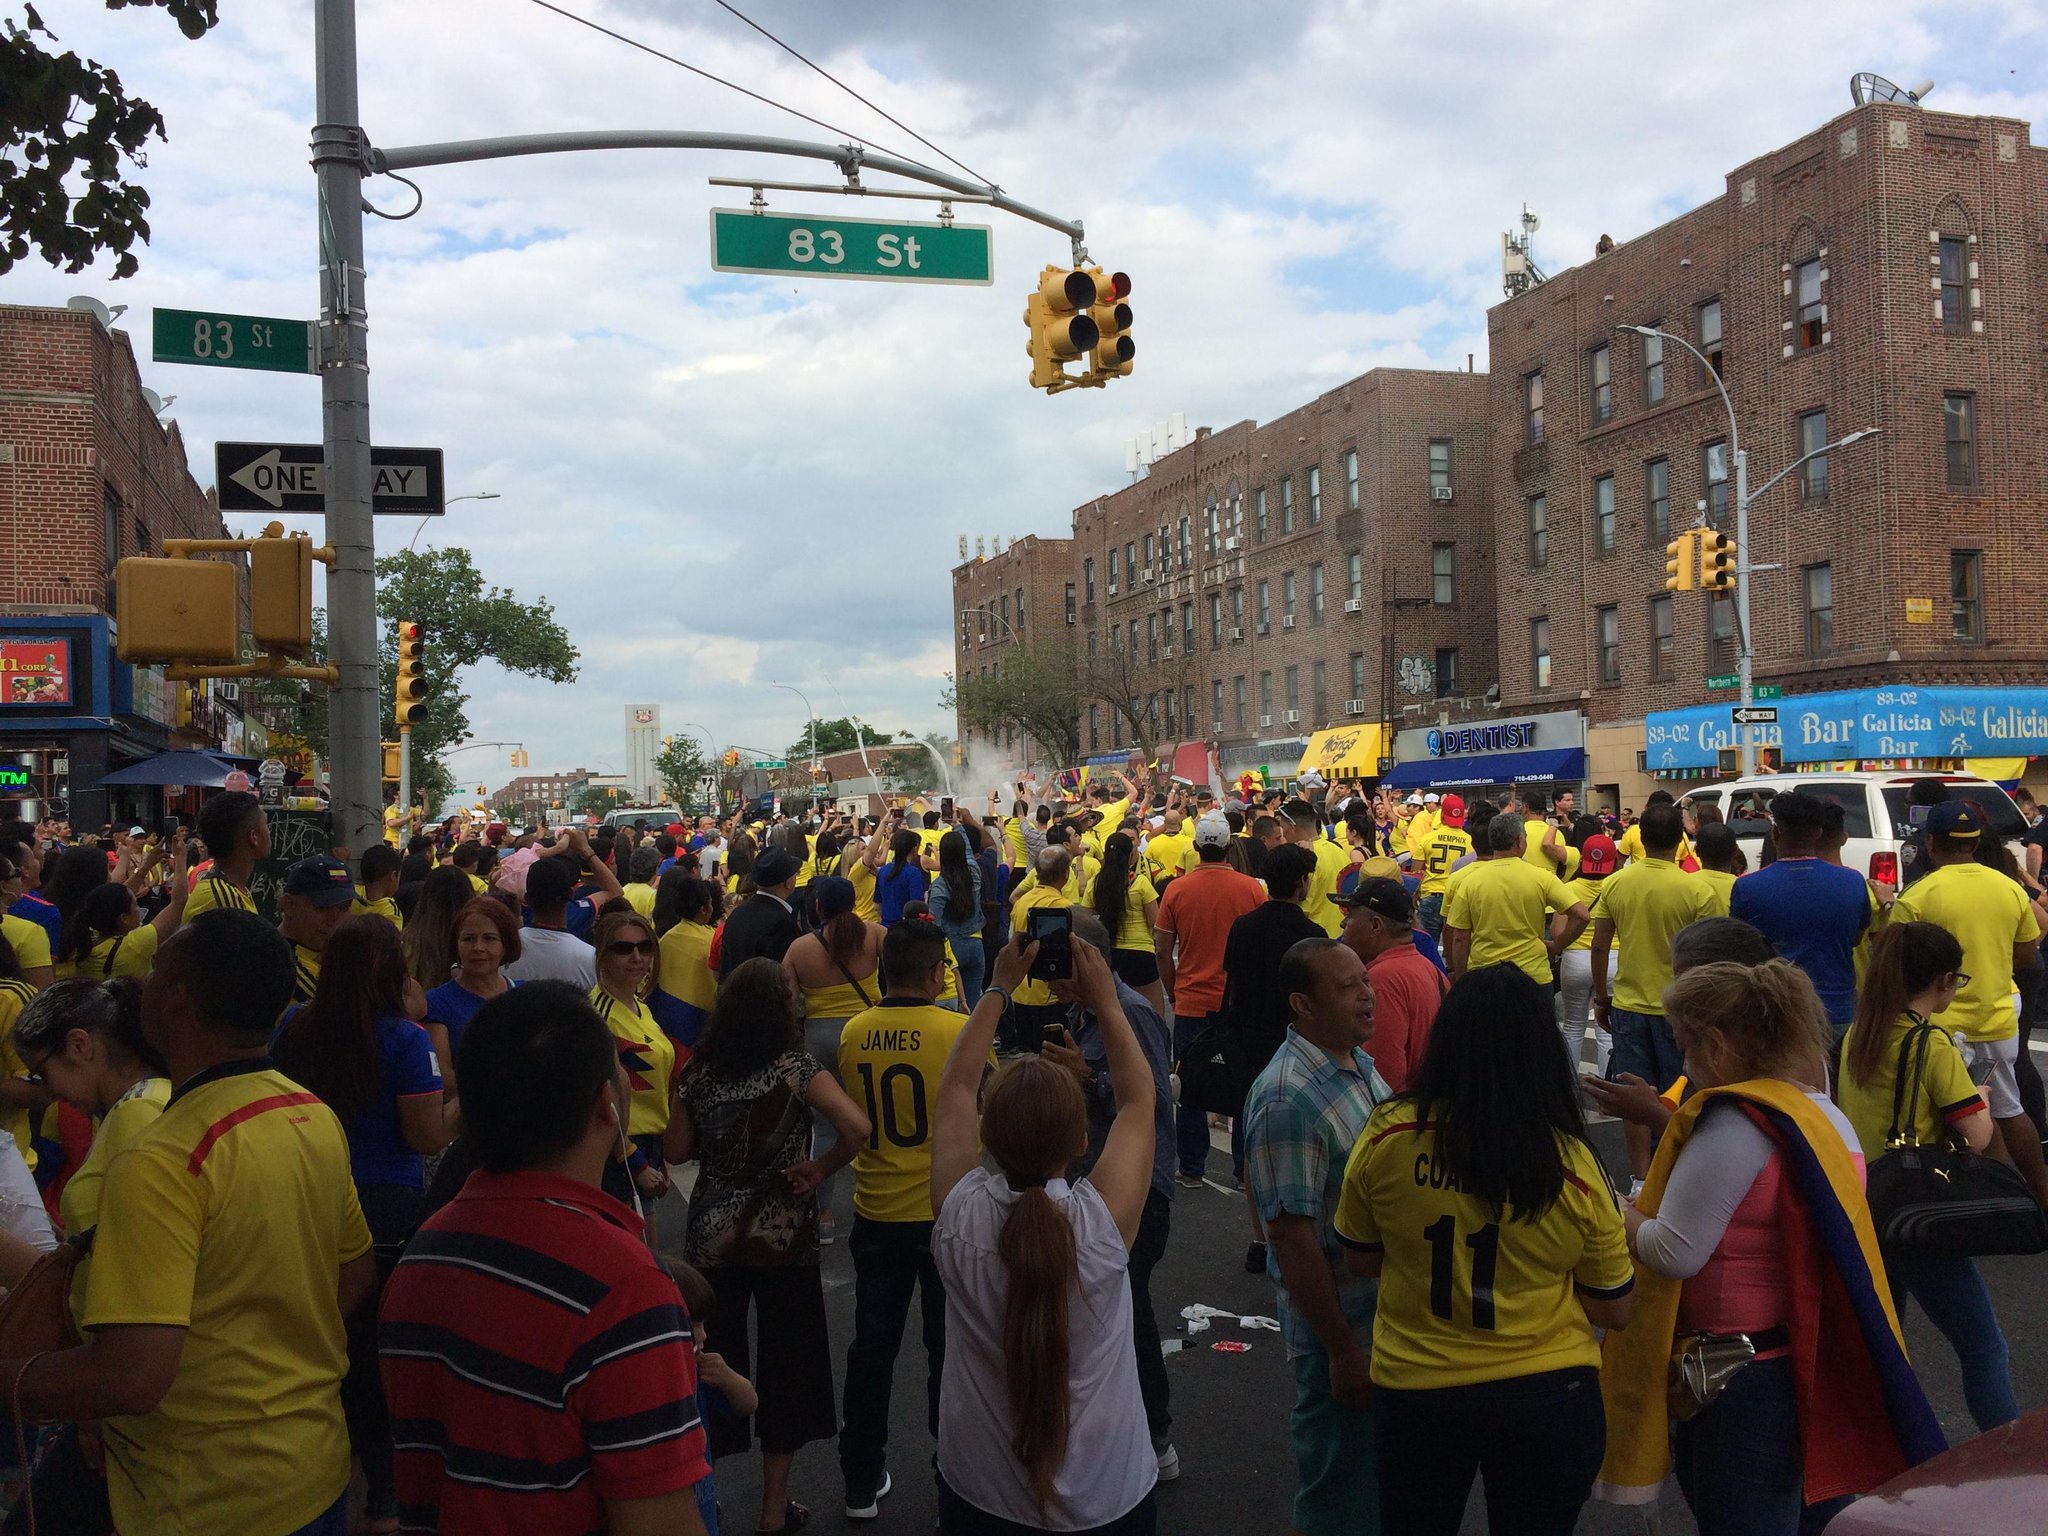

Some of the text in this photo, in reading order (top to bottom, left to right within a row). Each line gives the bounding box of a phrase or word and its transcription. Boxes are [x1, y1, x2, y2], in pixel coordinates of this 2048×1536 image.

[788, 228, 921, 269] 83 St
[193, 319, 273, 359] 83 St
[254, 465, 414, 493] ONE AY
[1758, 687, 1768, 698] 83
[1876, 691, 1918, 706] 83-02
[1739, 711, 1772, 720] ONE WAY
[1862, 713, 1932, 733] Galicia
[1939, 705, 2048, 739] 83-02 Galicia
[1445, 722, 1534, 753] DENTIST
[1648, 712, 1855, 752] 83-02 Galcia Bar
[1880, 736, 1920, 755] Bar
[0, 771, 27, 785] TM
[861, 1029, 921, 1052] JAMES
[857, 1062, 929, 1151] 10
[1423, 1214, 1500, 1331] 11
